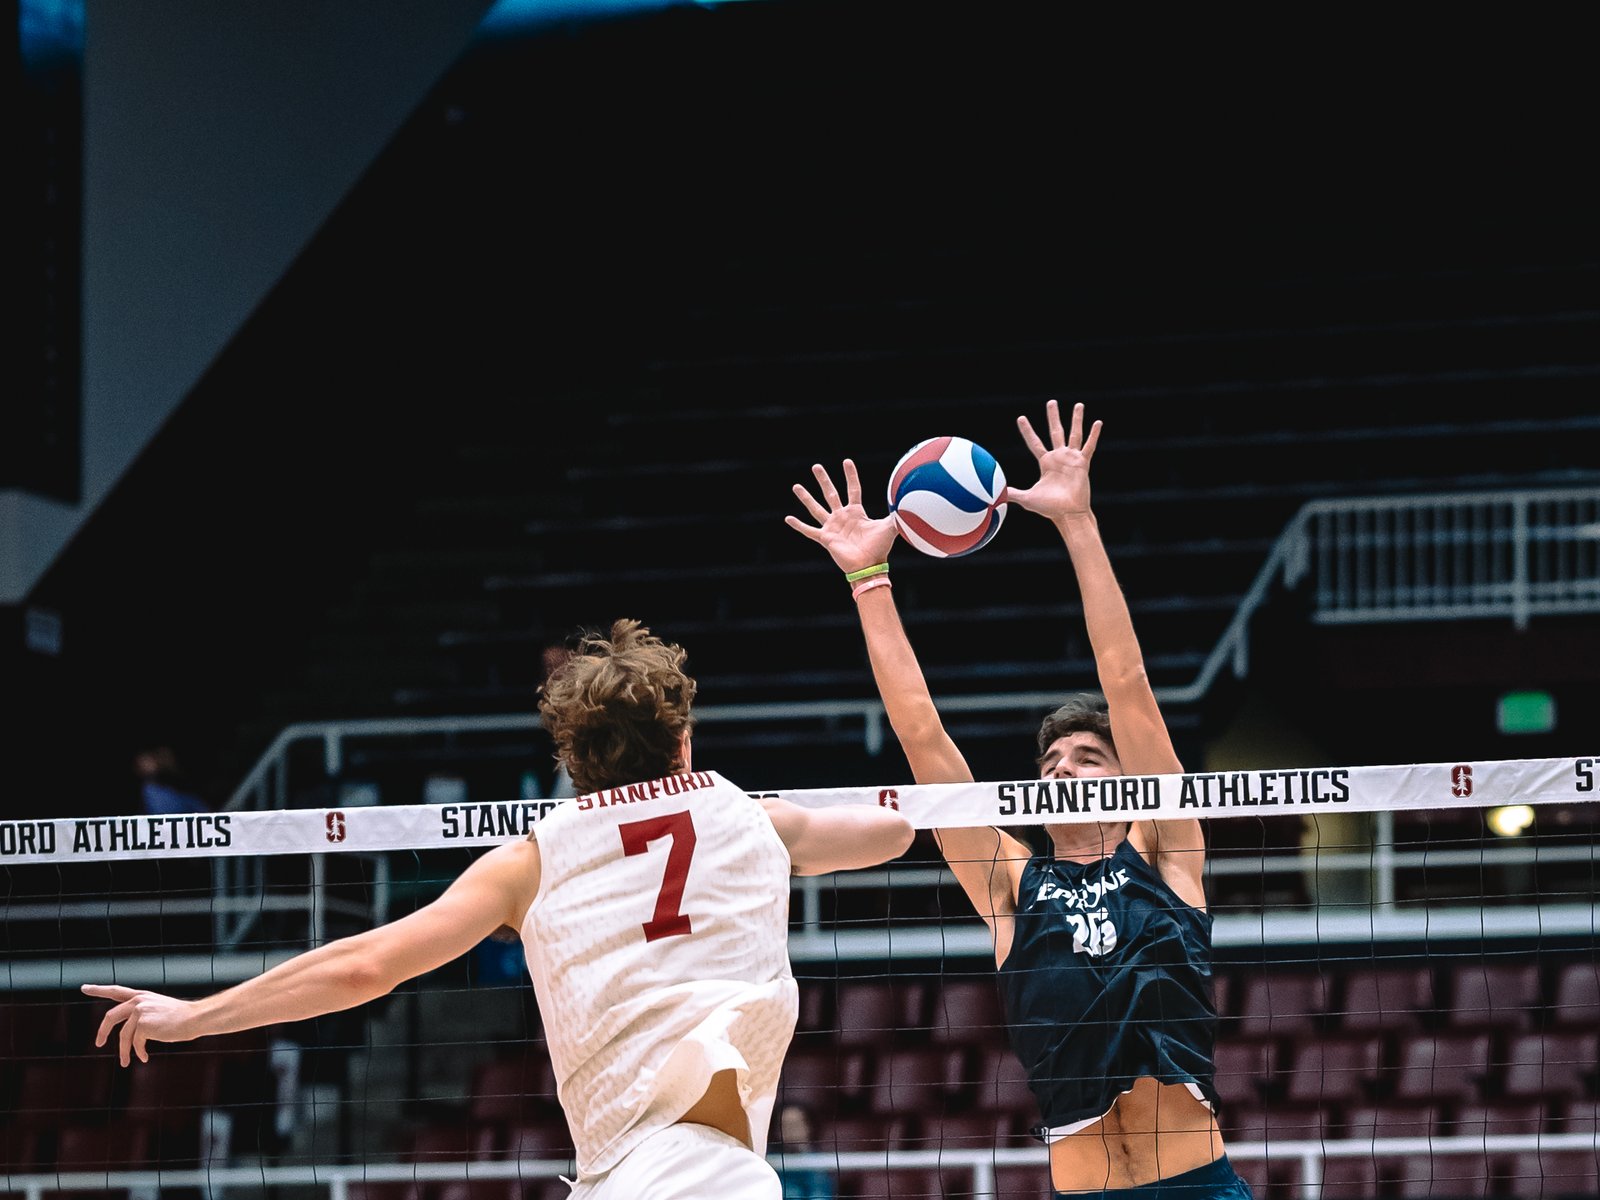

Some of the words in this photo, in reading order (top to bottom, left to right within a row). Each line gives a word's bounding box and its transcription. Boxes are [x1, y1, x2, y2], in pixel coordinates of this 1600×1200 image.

[576, 770, 715, 810] STANFORD
[998, 777, 1161, 815] STANFORD
[1179, 769, 1350, 808] ATHLETICS
[1576, 759, 1600, 792] S
[0, 822, 56, 855] ORD
[73, 815, 231, 853] ATHLETICS
[442, 802, 566, 838] STANF
[618, 809, 697, 942] 7
